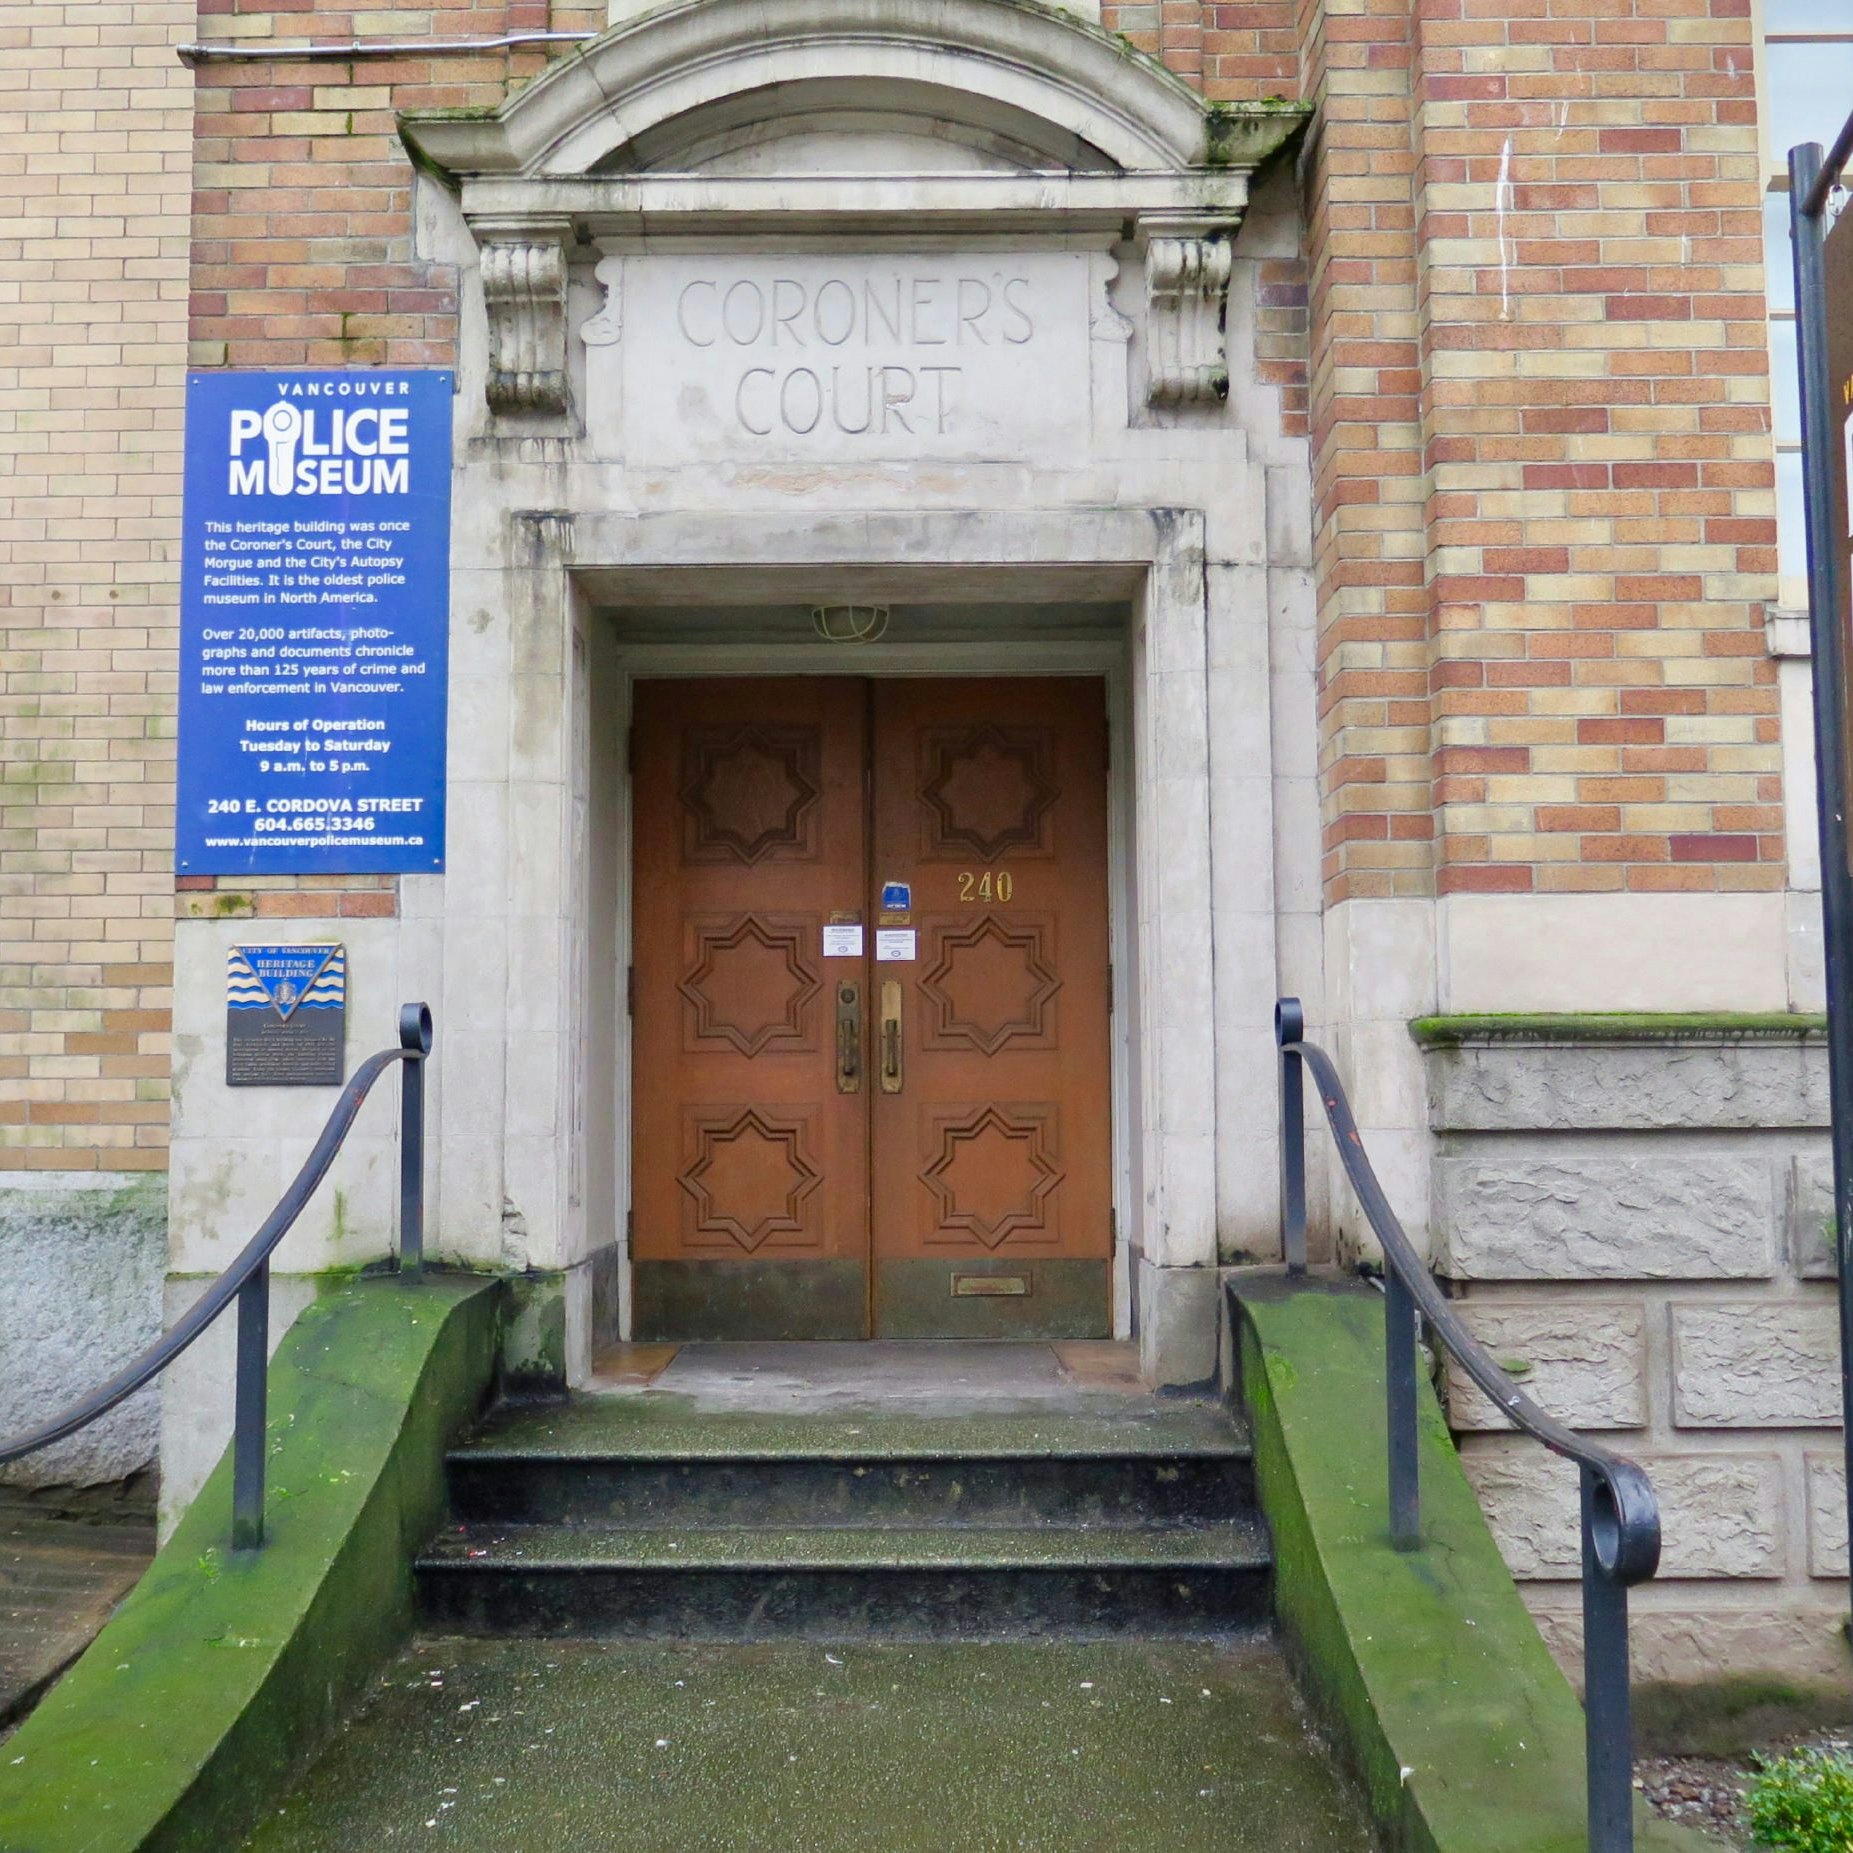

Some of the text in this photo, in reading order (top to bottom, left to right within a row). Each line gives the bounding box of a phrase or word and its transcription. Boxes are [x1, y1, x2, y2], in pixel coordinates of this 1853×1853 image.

[676, 272, 1035, 347] CORONER'S
[277, 382, 410, 396] VANCOUVER
[735, 366, 962, 436] COURT
[229, 401, 409, 457] POLICE
[229, 459, 409, 496] MUSEUM
[205, 520, 410, 535] This heritage building was once
[205, 538, 392, 551] the Coroner's Court, the City
[205, 556, 403, 571] Morgue and the City's Autopsy
[204, 573, 406, 587] Facilities. It is the oldest police
[204, 592, 378, 605] museum in North America.
[202, 627, 394, 642] Over 20,000 artifacts, photo-
[202, 645, 414, 660] graphs and documents chronicle
[202, 662, 426, 677] more than 125 years of crime and
[202, 681, 404, 694] law enforcement in Vancouver.
[246, 719, 385, 733] Hours of Operation
[240, 739, 391, 754] Tuesday to Saturday
[260, 760, 369, 774] 9 a.m. to 5 p.m.
[208, 798, 423, 814] 240 E. CORDOVA STREET
[254, 818, 375, 832] 604.665.3346
[206, 835, 423, 848] www.vancouverpolicemuseum.ca
[957, 872, 1013, 902] 240
[257, 960, 315, 968] HERITAGE
[259, 969, 313, 977] BUILDING
